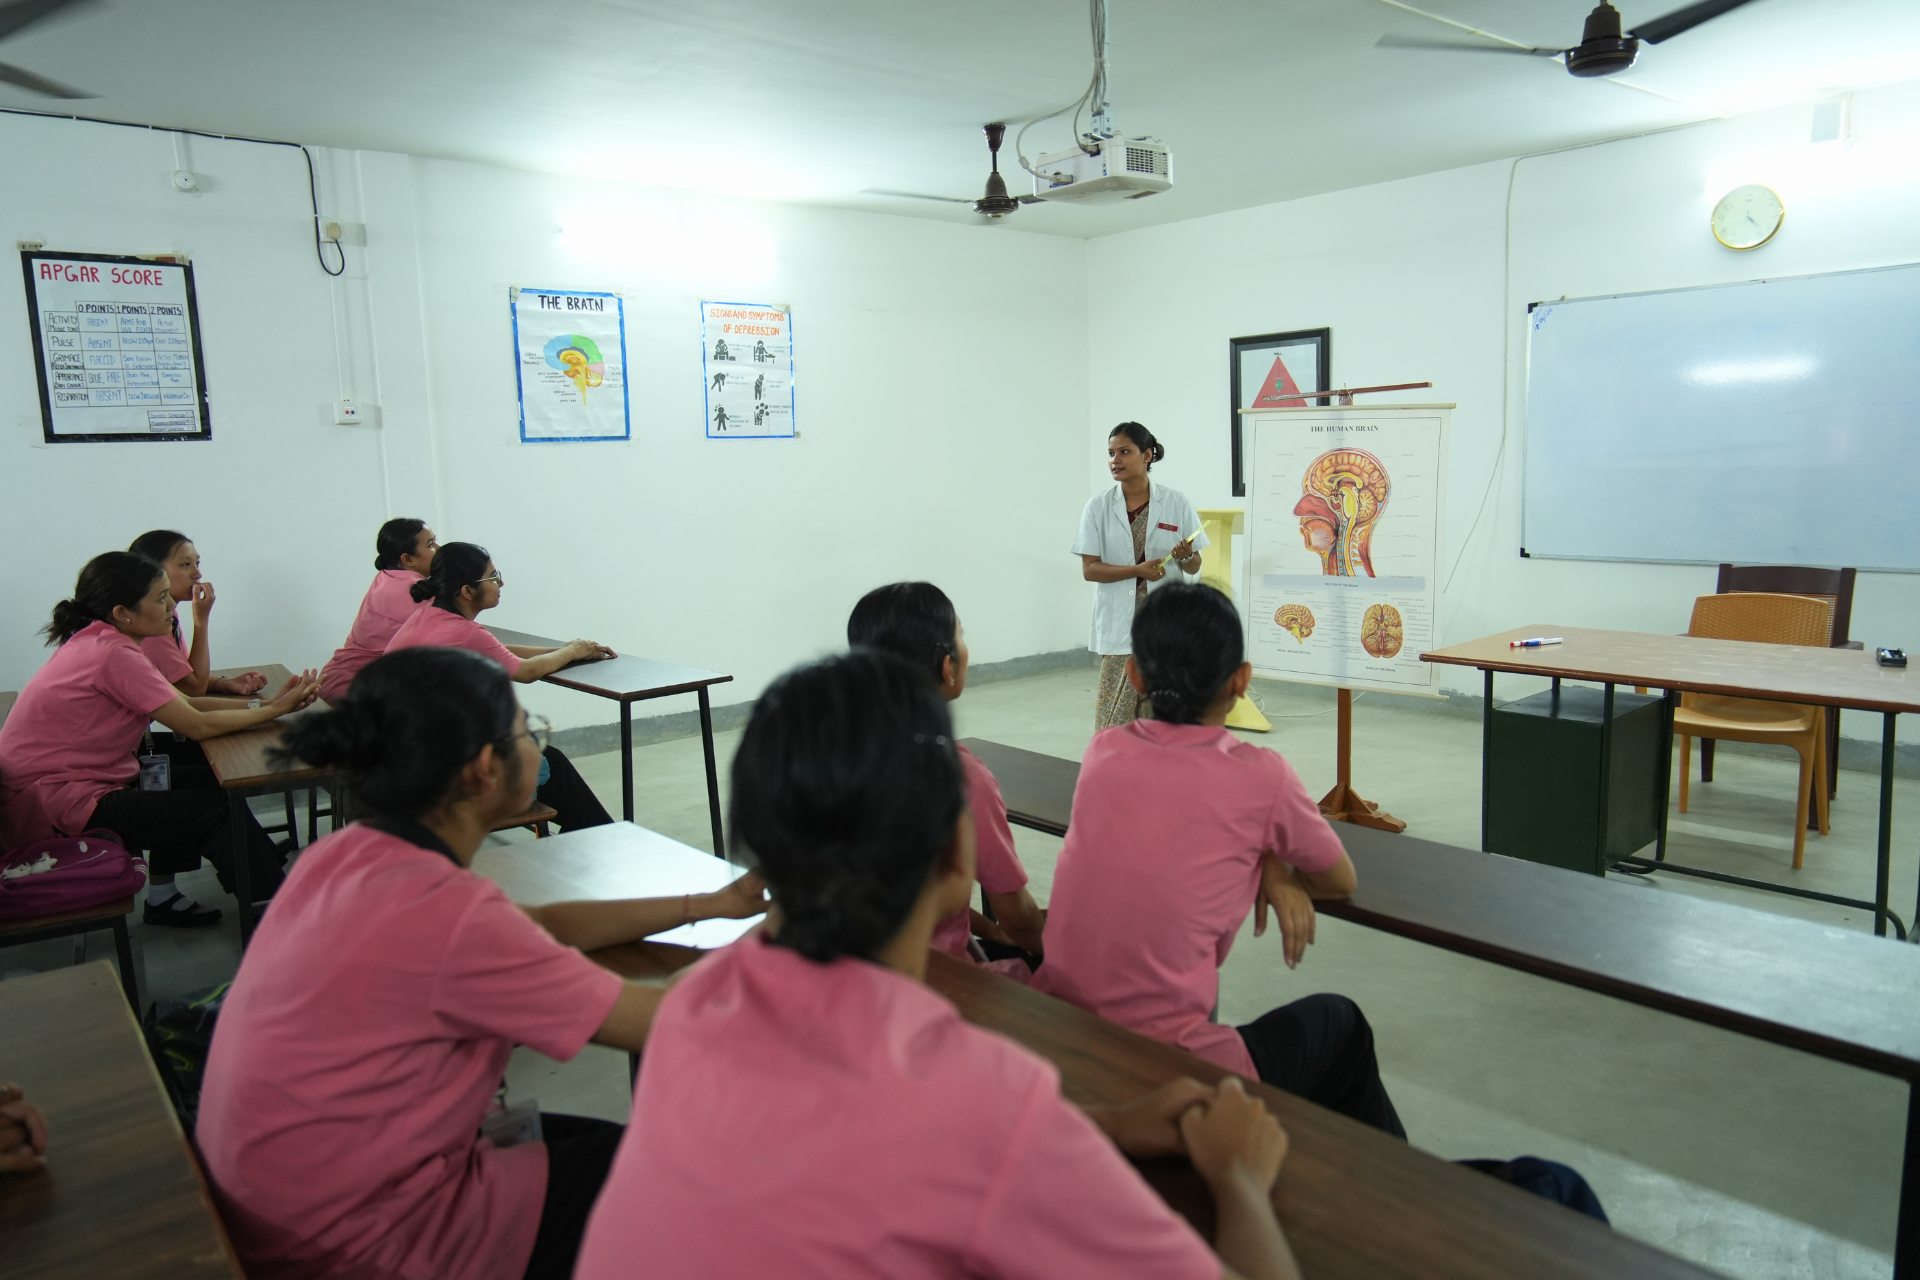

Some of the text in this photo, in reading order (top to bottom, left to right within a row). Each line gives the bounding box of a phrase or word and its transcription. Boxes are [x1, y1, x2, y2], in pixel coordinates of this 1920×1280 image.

[40, 263, 163, 286] APGAR SCORE
[78, 304, 115, 313] 0 POINTS
[122, 305, 147, 314] POINTS
[538, 295, 604, 312] THE BRAIN
[150, 306, 182, 315] 2 POINTS
[733, 310, 747, 319] AND
[748, 311, 784, 322] SYMPTOMS
[723, 323, 780, 336] OF DEPRESSION
[51, 335, 74, 347] PULSE
[95, 389, 123, 402] ABSENT
[1310, 425, 1325, 433] THE
